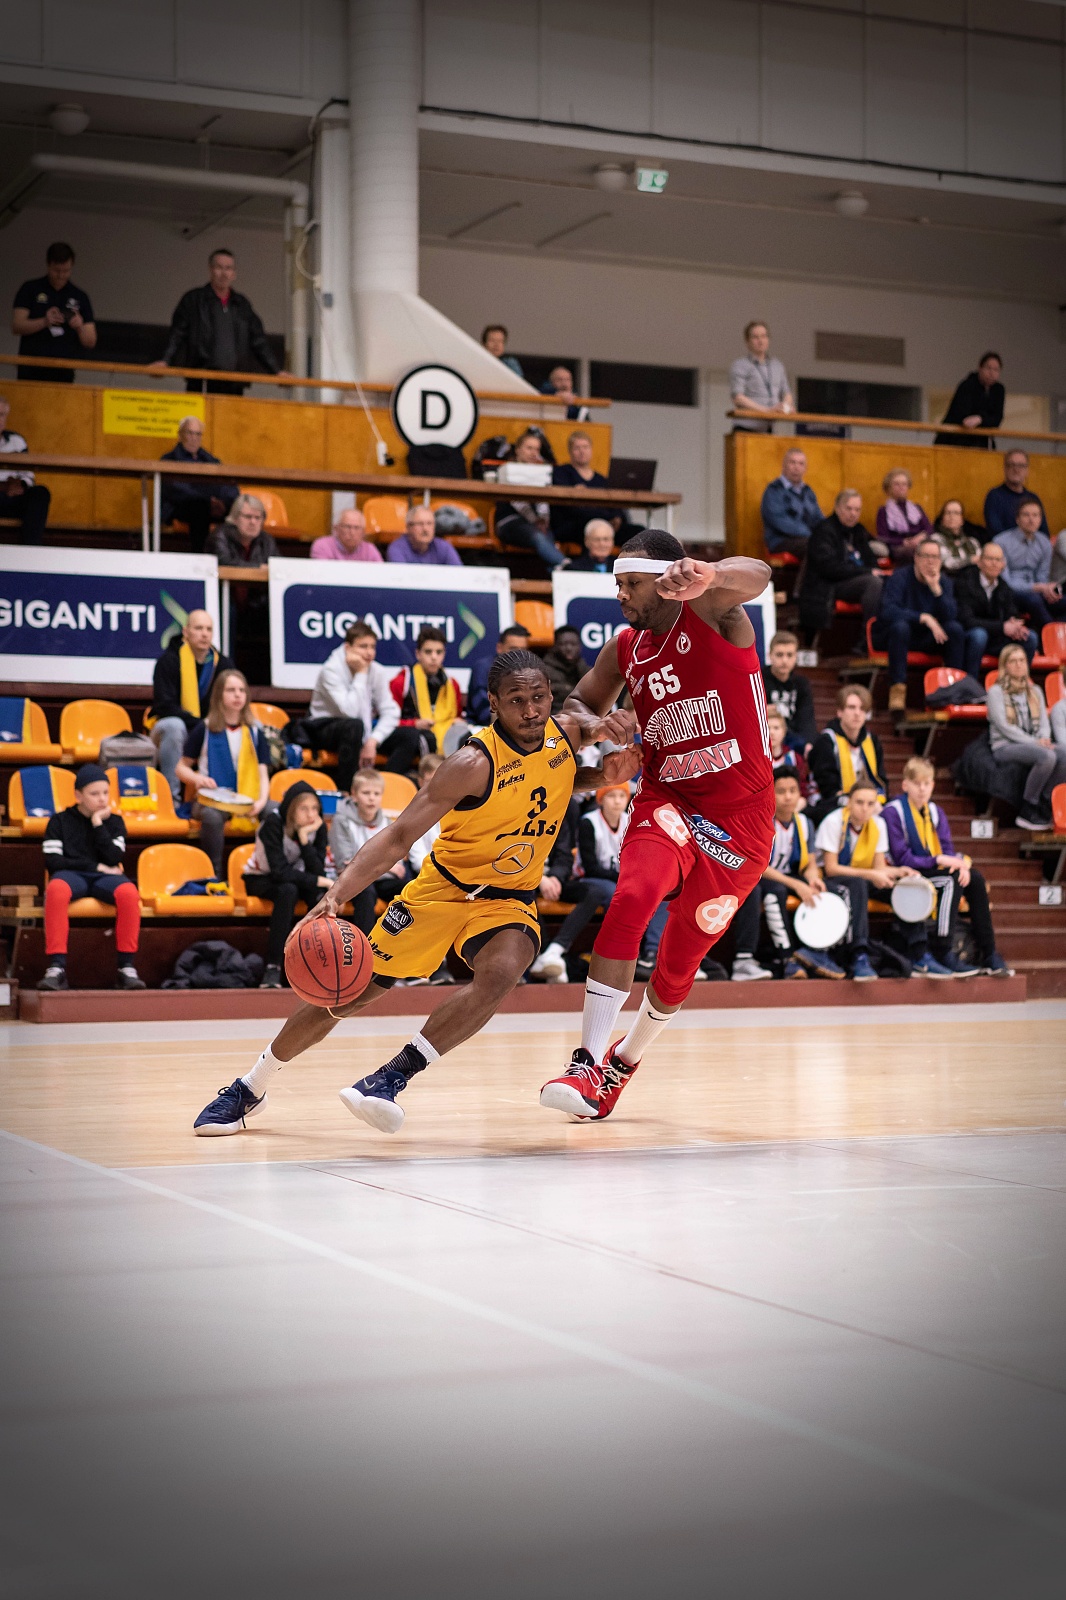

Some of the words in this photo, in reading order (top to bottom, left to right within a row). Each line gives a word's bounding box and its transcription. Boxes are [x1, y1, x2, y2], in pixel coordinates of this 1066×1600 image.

[421, 390, 451, 430] D
[0, 598, 156, 633] GIGANTTI
[647, 663, 682, 701] 65
[659, 740, 733, 781] AVANT
[527, 785, 548, 820] 3
[696, 819, 724, 838] Ford
